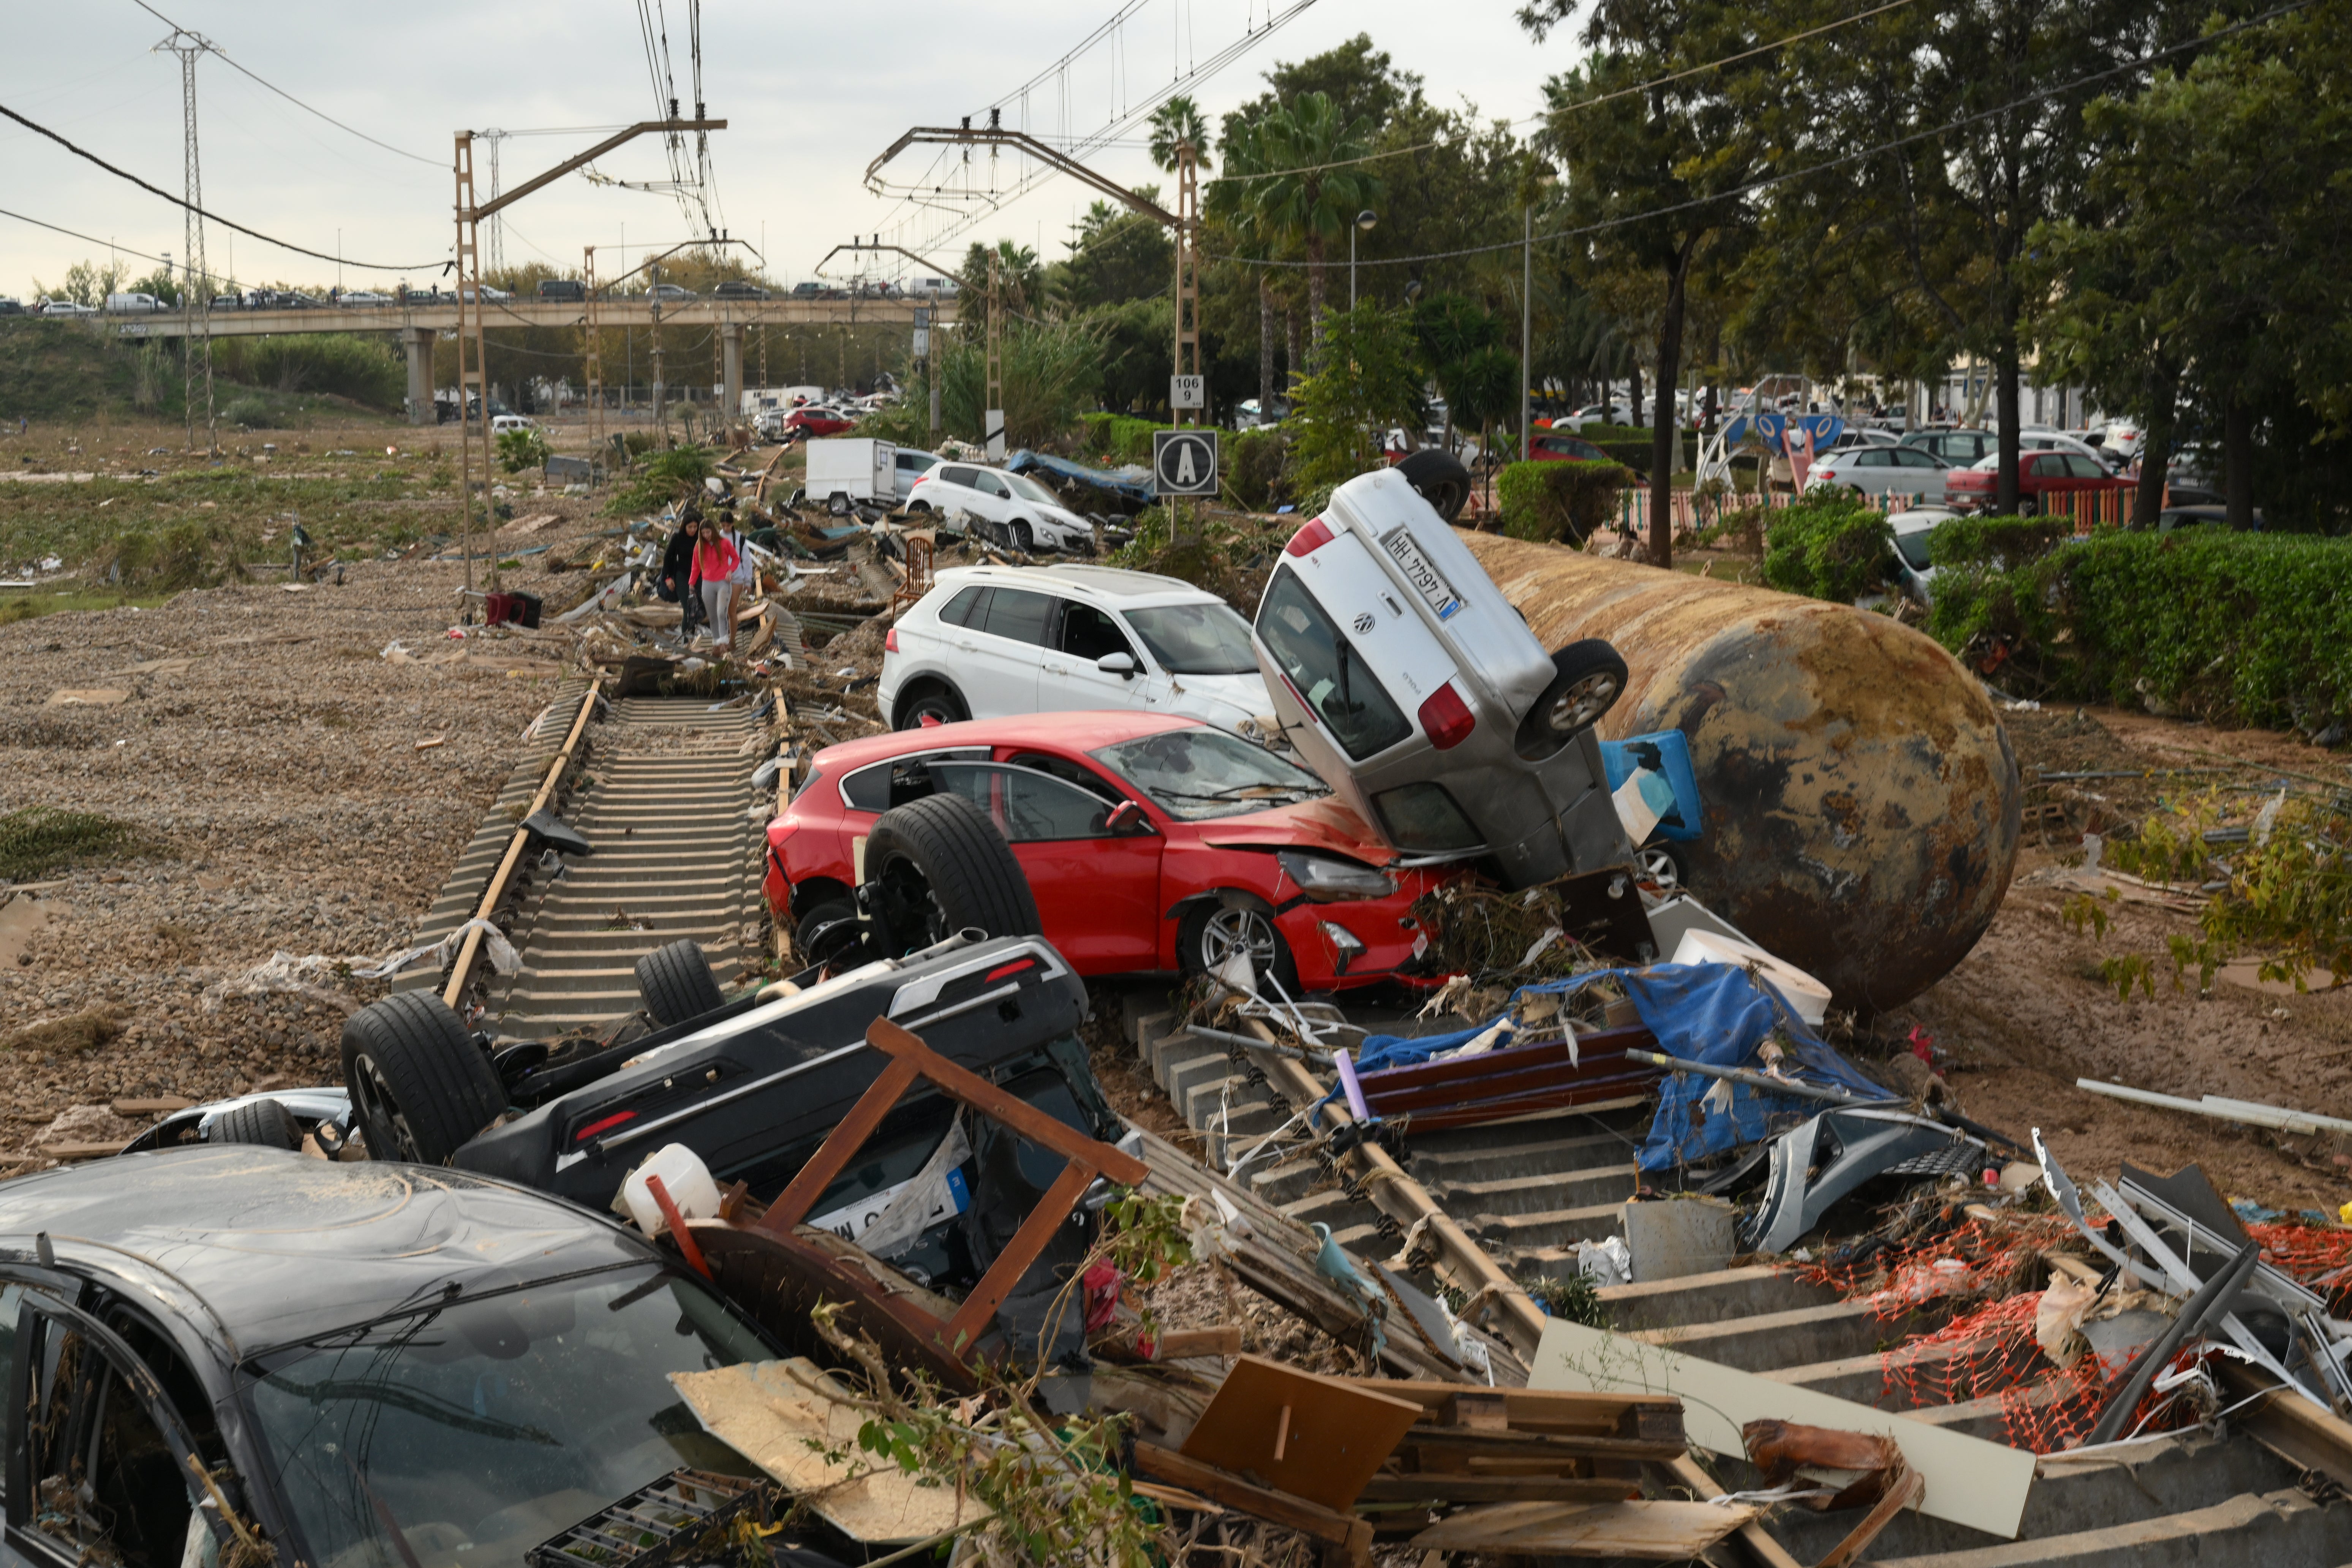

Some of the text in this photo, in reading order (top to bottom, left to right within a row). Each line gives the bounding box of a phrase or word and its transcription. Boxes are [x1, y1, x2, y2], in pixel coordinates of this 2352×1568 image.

[1176, 378, 1198, 389] 106
[1184, 390, 1191, 401] 9
[1176, 443, 1196, 483] A
